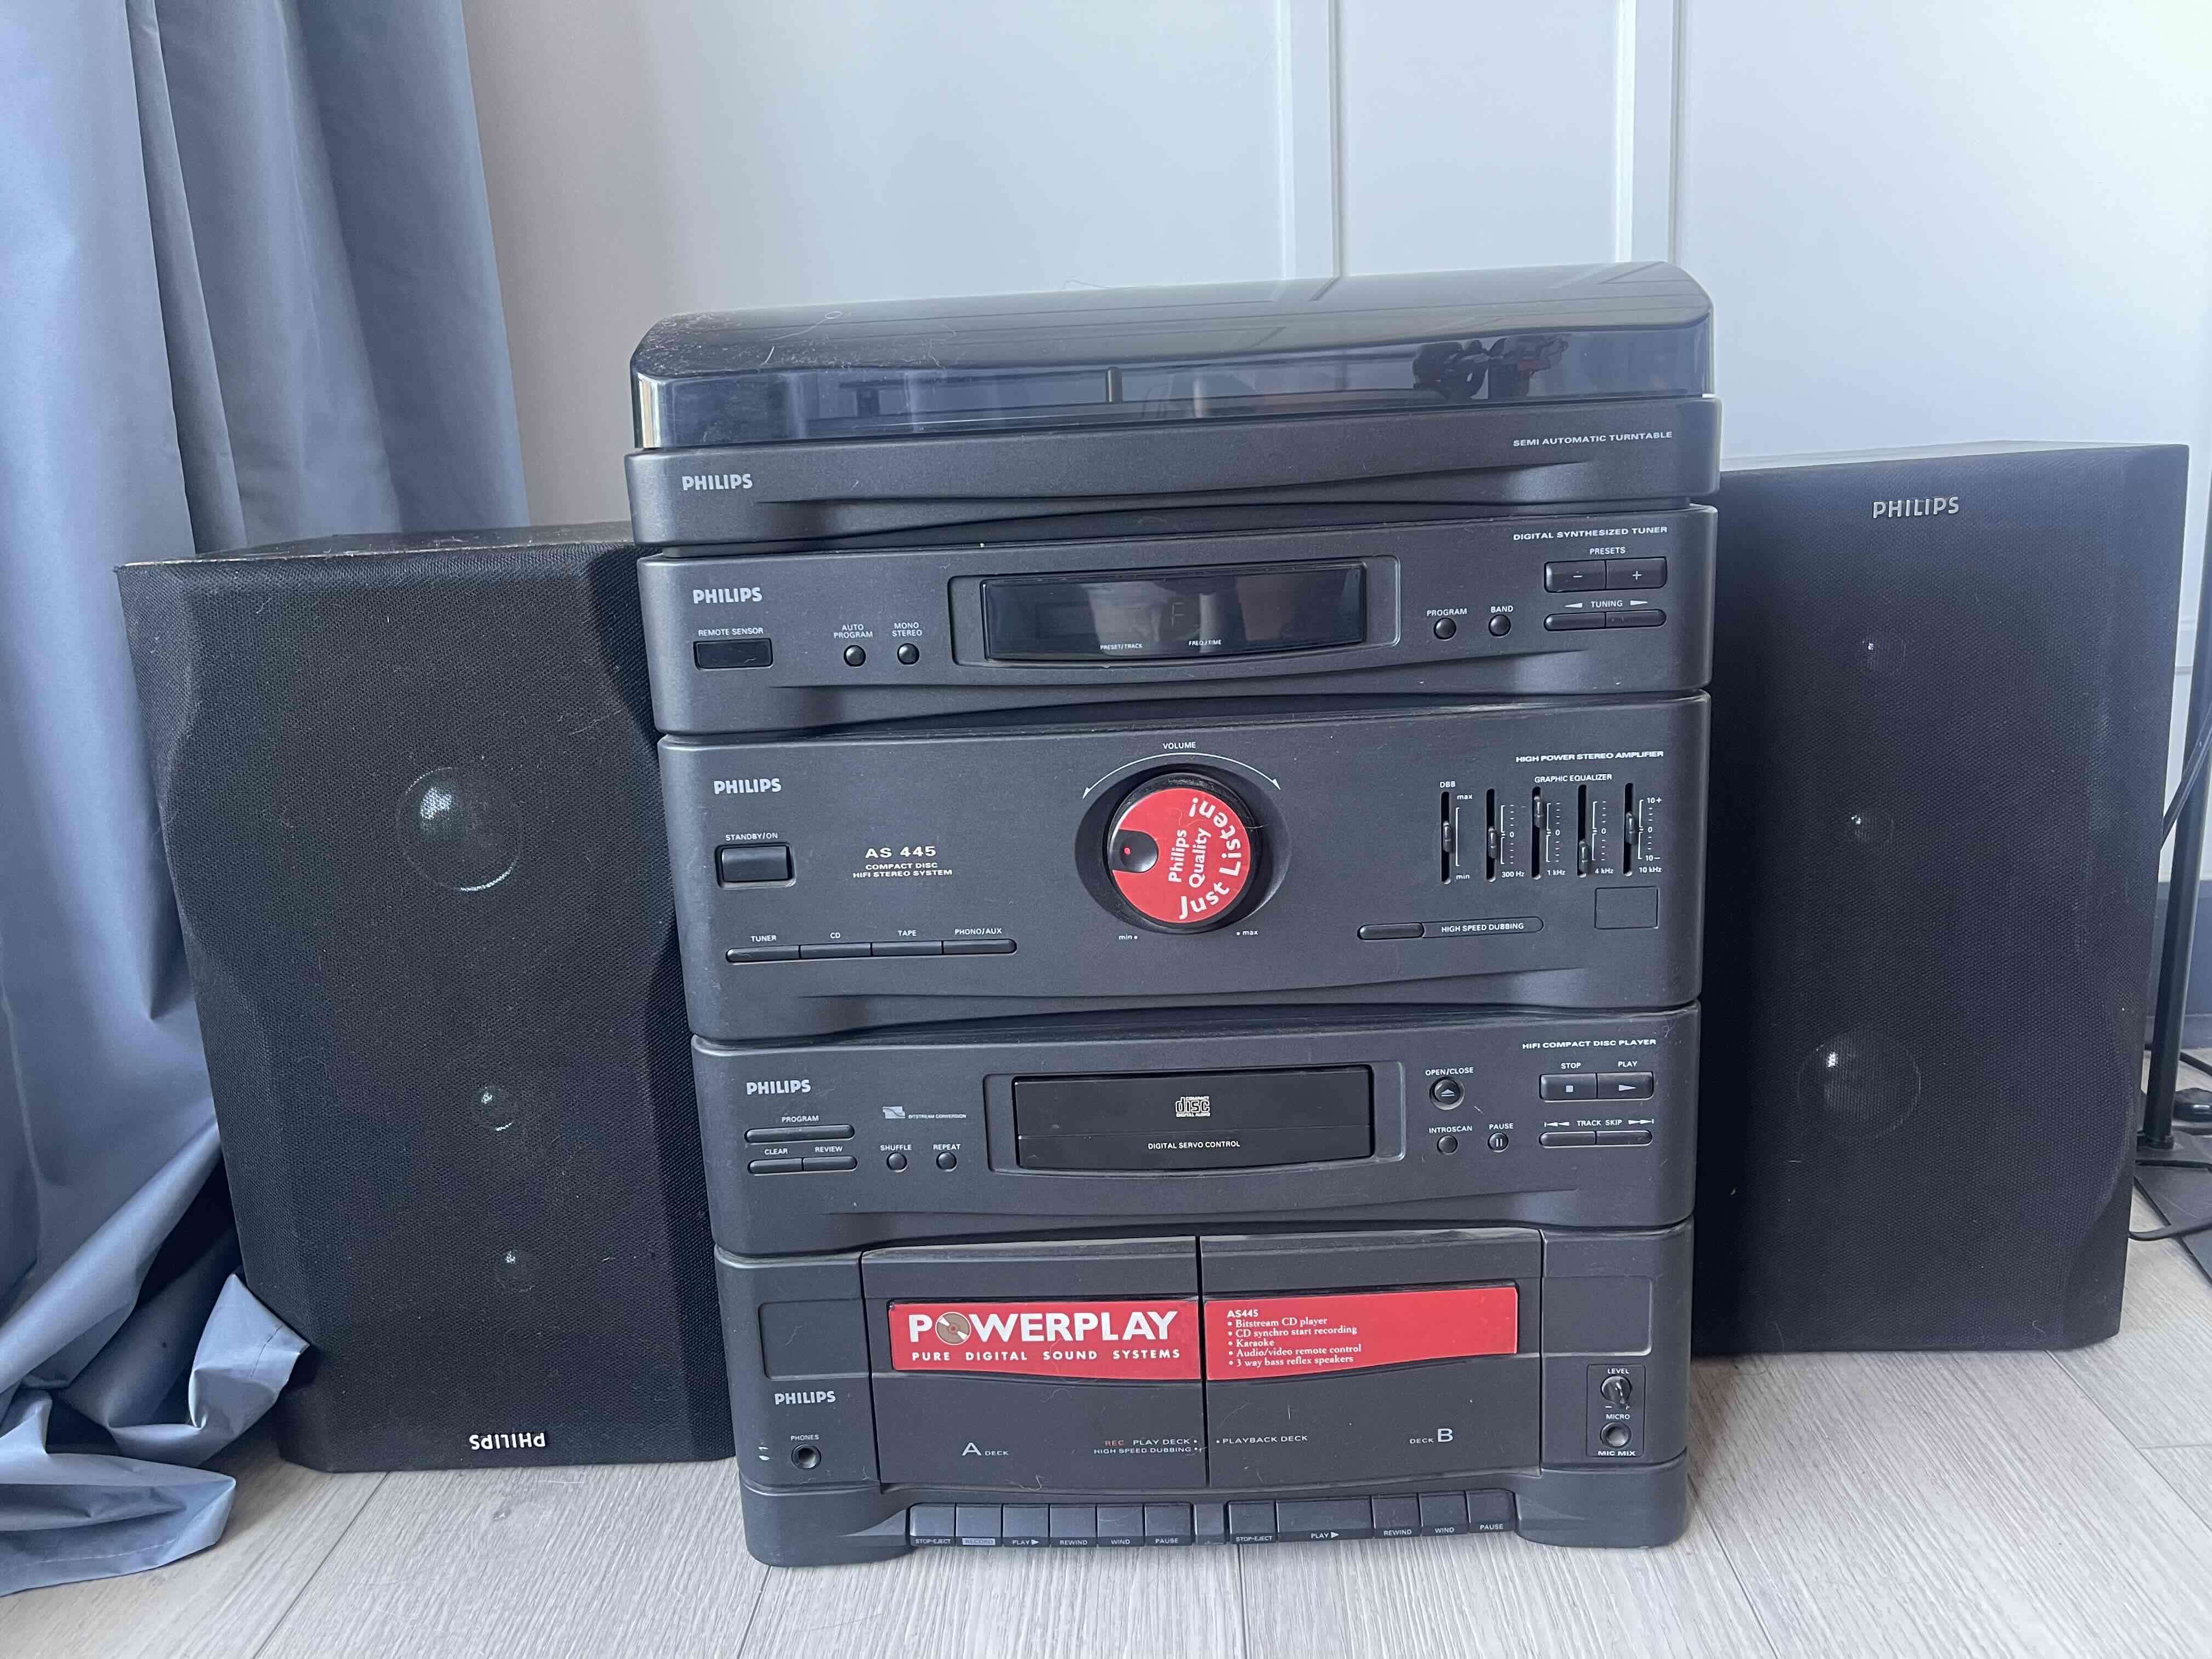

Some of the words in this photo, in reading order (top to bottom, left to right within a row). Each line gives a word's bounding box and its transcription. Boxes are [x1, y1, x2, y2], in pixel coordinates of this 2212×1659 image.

[1542, 435, 1606, 444] AUTOMATIC
[1610, 432, 1672, 441] TURNTABLE
[682, 474, 753, 490] PHILIPS
[1873, 496, 1959, 518] PHILIPS
[1513, 532, 1554, 540] DIGITAL
[1556, 528, 1629, 539] SYNTHESIZED
[693, 587, 763, 603] PHILIPS
[1427, 608, 1468, 617] PROGRAM
[698, 628, 729, 636] REMOTE
[714, 778, 781, 794] PHILIPS
[725, 833, 778, 841] STANDBY/ON
[1189, 797, 1242, 877] Listen!
[865, 848, 892, 859] AS
[900, 846, 936, 857] 445
[1168, 828, 1190, 883] Philips
[1189, 827, 1211, 888] Quality
[1179, 881, 1230, 920] Just
[1462, 924, 1487, 932] SPEED
[1488, 922, 1524, 931] DUBBING
[1425, 1066, 1474, 1076] OPEN/CLOSE
[746, 1079, 811, 1095] PHILIPS
[1429, 1125, 1472, 1133] INTROSCAN
[908, 1311, 1178, 1345] POWERPLAY
[1235, 1319, 1278, 1328] Bitstream
[1282, 1317, 1297, 1325] CD
[1300, 1317, 1328, 1327] player
[1235, 1329, 1251, 1338] CD
[1254, 1328, 1289, 1338] synchro
[1314, 1325, 1357, 1334] recording
[1236, 1339, 1274, 1347] Karaoke
[912, 1352, 951, 1361] PURE
[966, 1351, 1027, 1361] DIGITAL
[1043, 1350, 1097, 1360] SOUND
[1113, 1349, 1180, 1359] SYSTEMS
[1237, 1348, 1293, 1357] Audio/video
[1296, 1346, 1327, 1355] remote
[1329, 1344, 1361, 1353] control
[1237, 1359, 1241, 1367] 3
[1287, 1356, 1311, 1364] reflex
[1314, 1355, 1353, 1364] speakers
[775, 1391, 836, 1404] PHILIPS
[469, 1432, 545, 1450] PHILIPS
[1437, 1428, 1453, 1443] B
[962, 1442, 982, 1457] A
